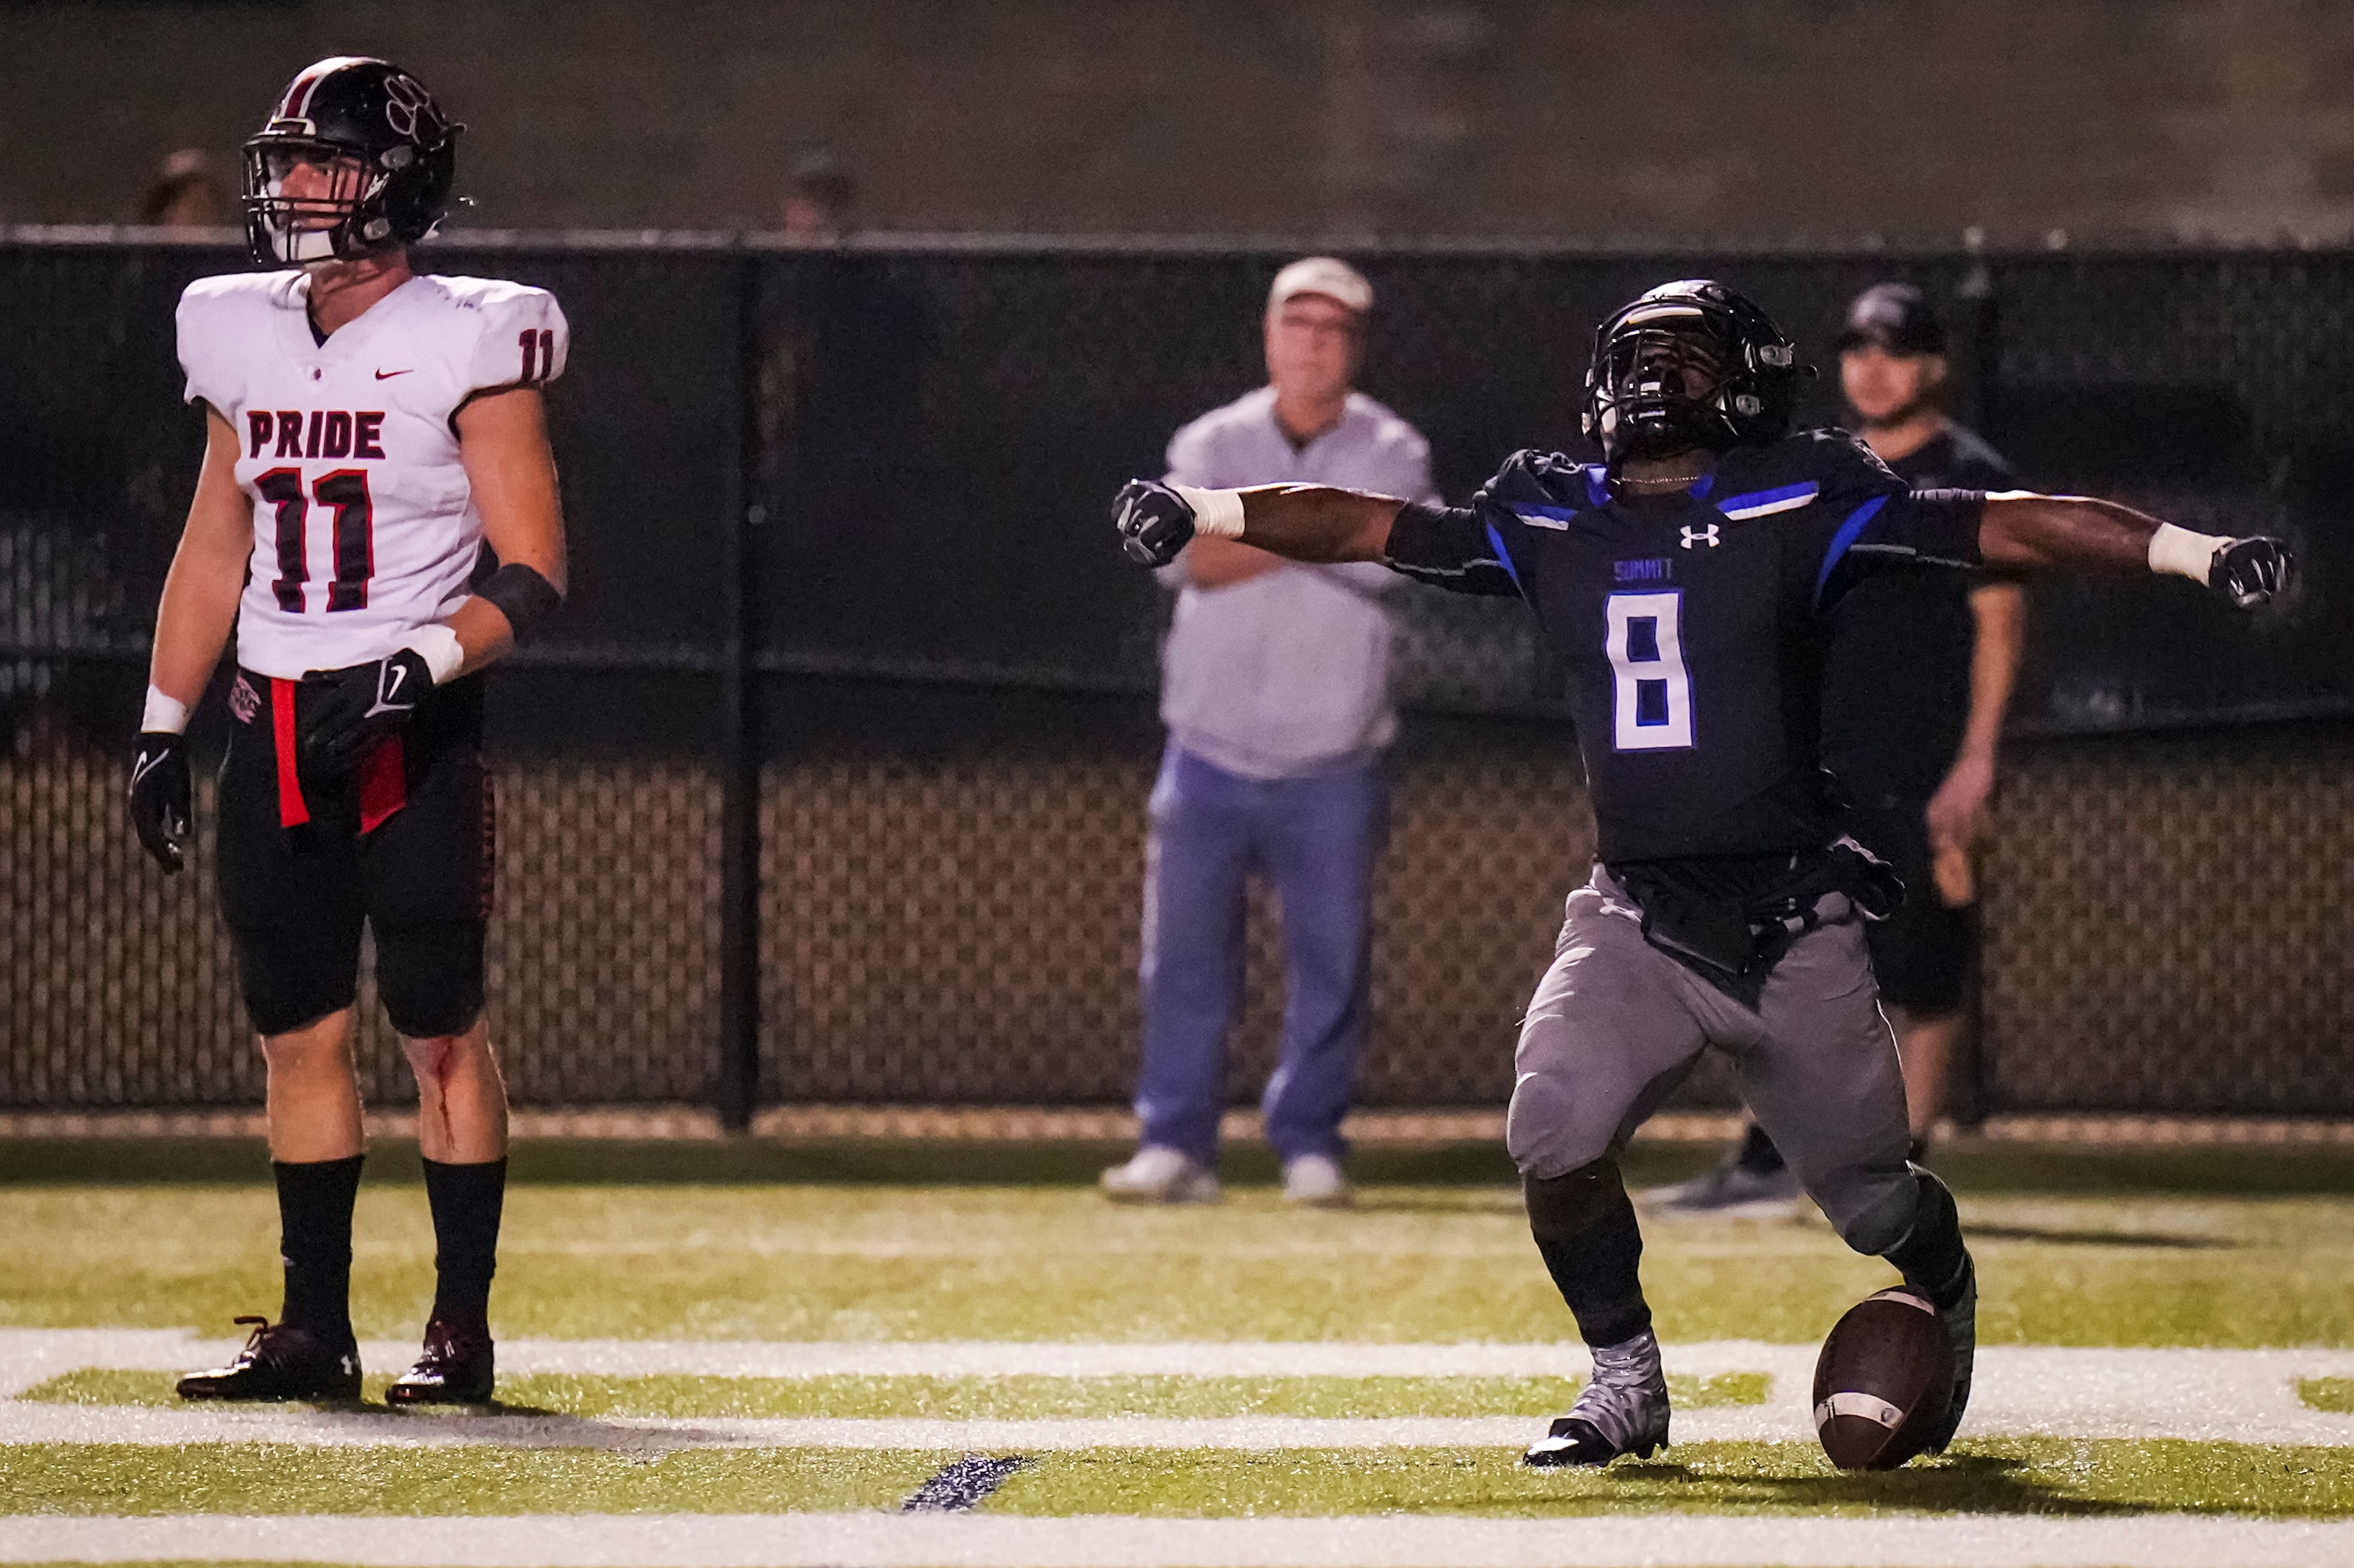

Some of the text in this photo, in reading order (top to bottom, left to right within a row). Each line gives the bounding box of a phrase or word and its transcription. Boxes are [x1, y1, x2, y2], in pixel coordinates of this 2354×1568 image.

[519, 328, 553, 380] 11
[247, 410, 385, 459] PRIDE
[254, 468, 374, 613] 11
[1613, 559, 1672, 582] SUMMIT
[1606, 589, 1694, 751] 8
